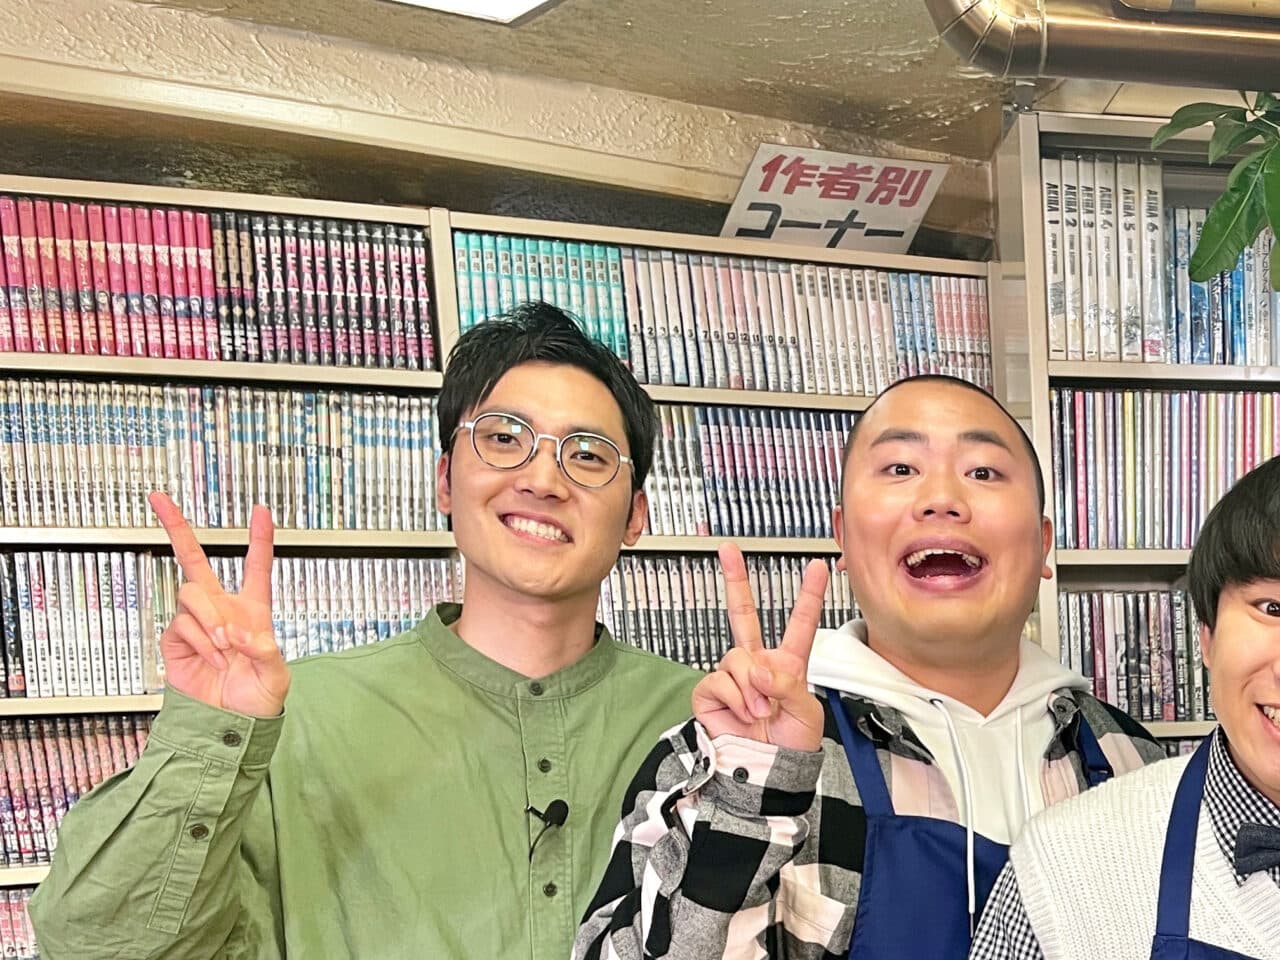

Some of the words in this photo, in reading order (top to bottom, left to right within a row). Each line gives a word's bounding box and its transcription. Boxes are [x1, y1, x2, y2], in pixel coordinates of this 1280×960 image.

[759, 154, 933, 207] 作者別
[735, 202, 904, 249] コーナー
[253, 236, 270, 306] HEAT
[269, 236, 285, 307] HEAT
